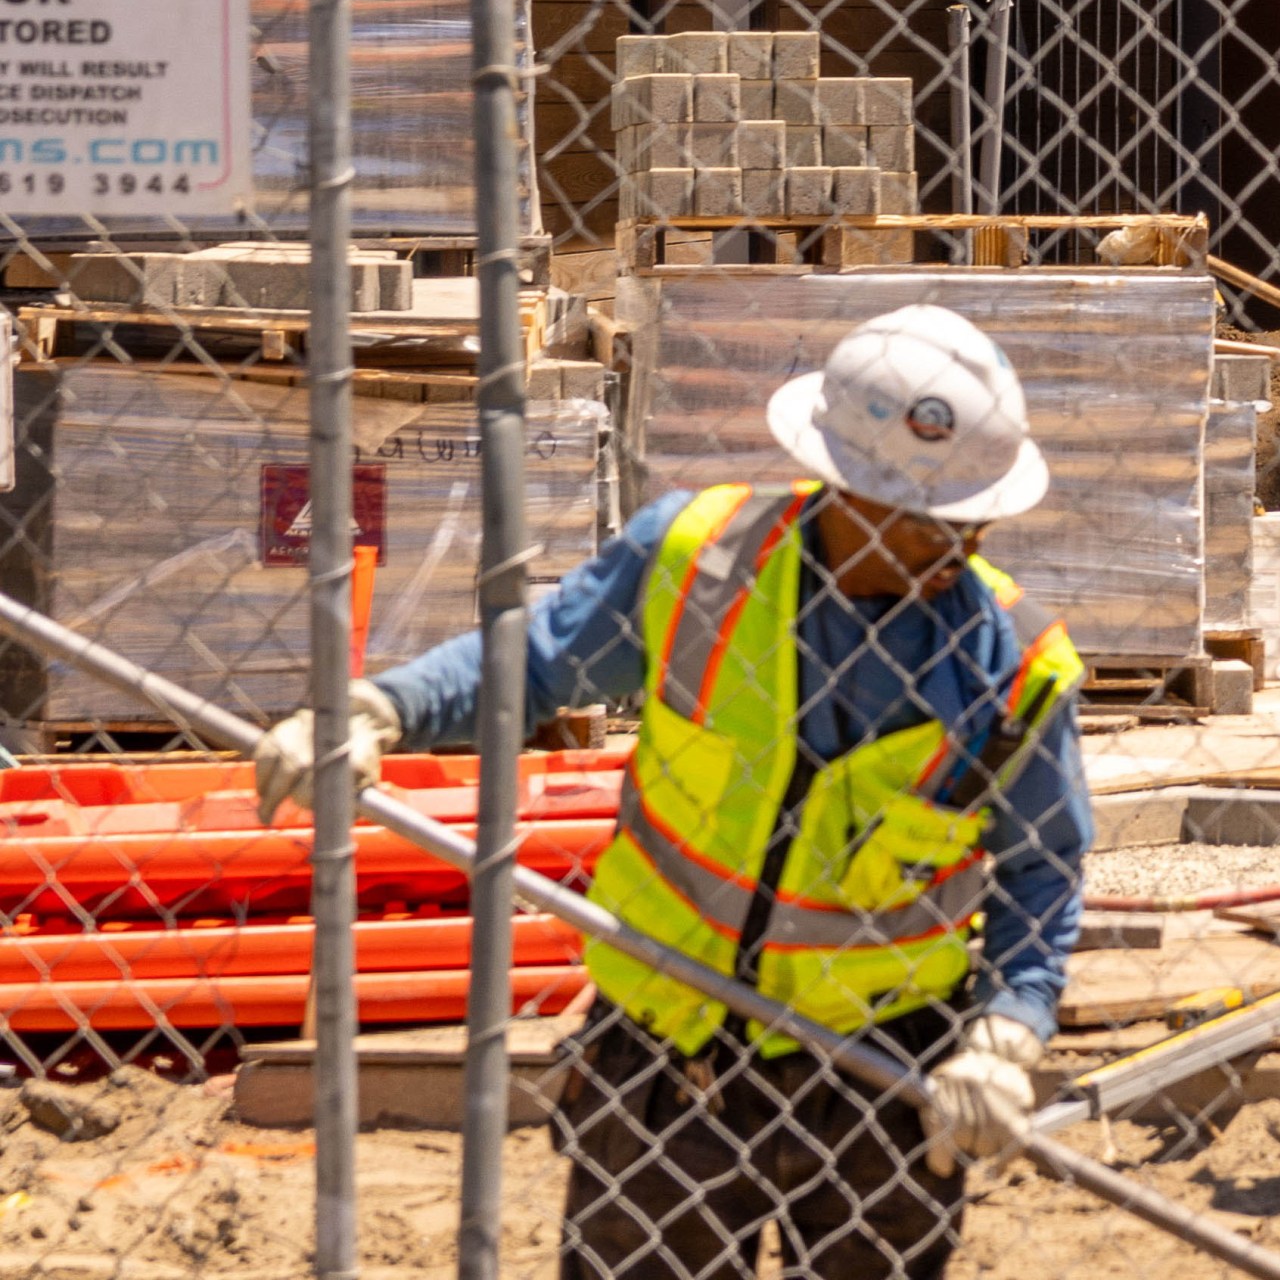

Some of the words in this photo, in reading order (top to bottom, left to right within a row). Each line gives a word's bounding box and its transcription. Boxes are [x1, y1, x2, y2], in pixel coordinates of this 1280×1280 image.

[18, 60, 72, 79] WILL
[80, 60, 168, 79] RESULT
[29, 84, 142, 102] DISPATCH
[94, 171, 191, 194] 3944
